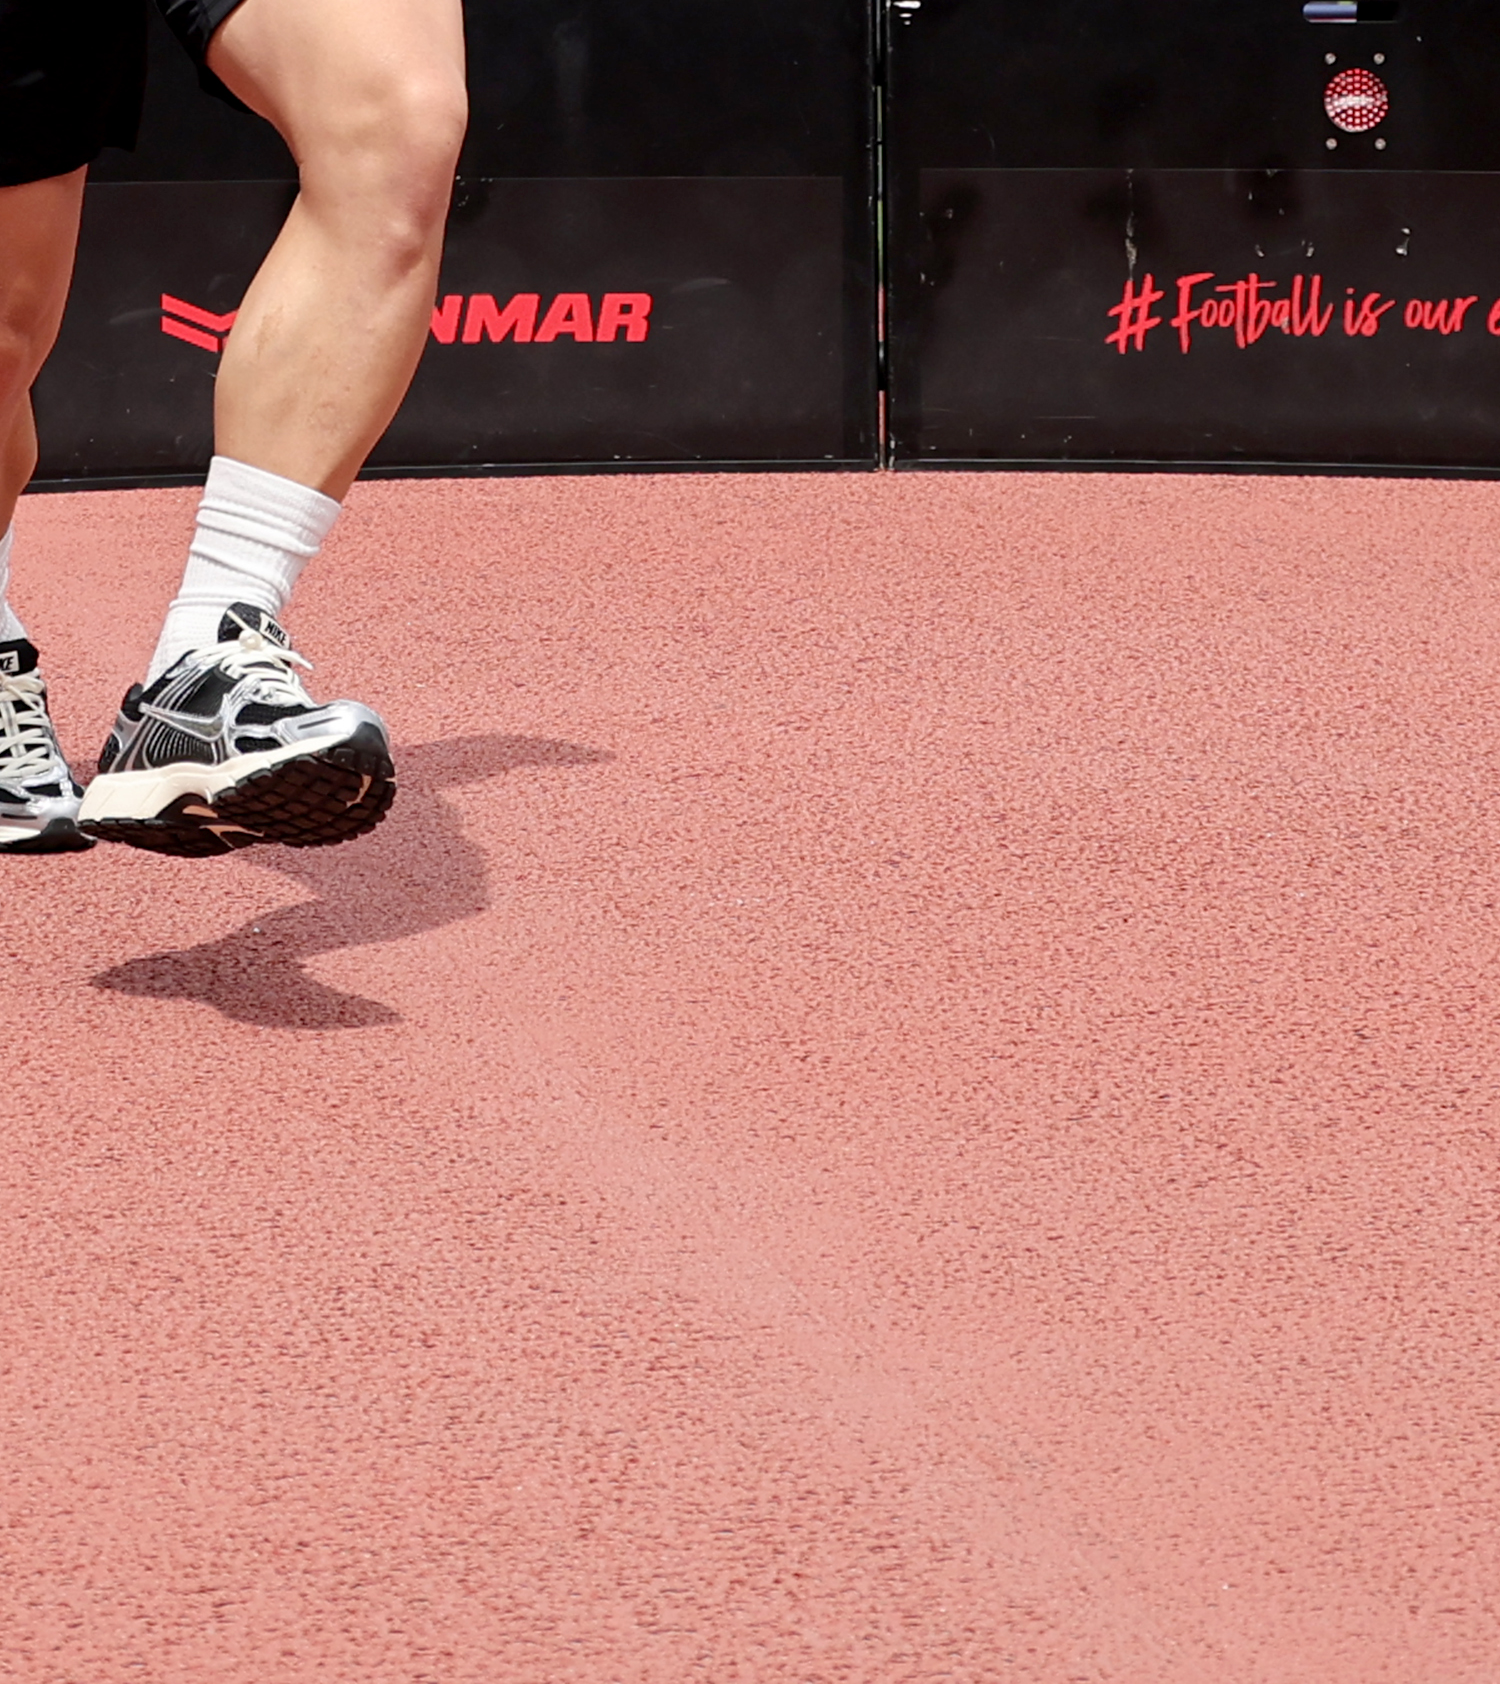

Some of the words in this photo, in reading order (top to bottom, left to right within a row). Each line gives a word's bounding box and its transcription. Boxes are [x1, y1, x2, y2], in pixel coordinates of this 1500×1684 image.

[429, 292, 654, 344] NMAR
[1104, 272, 1334, 354] #Football
[1343, 286, 1396, 337] is
[1404, 295, 1478, 335] our
[263, 620, 288, 647] NIKE
